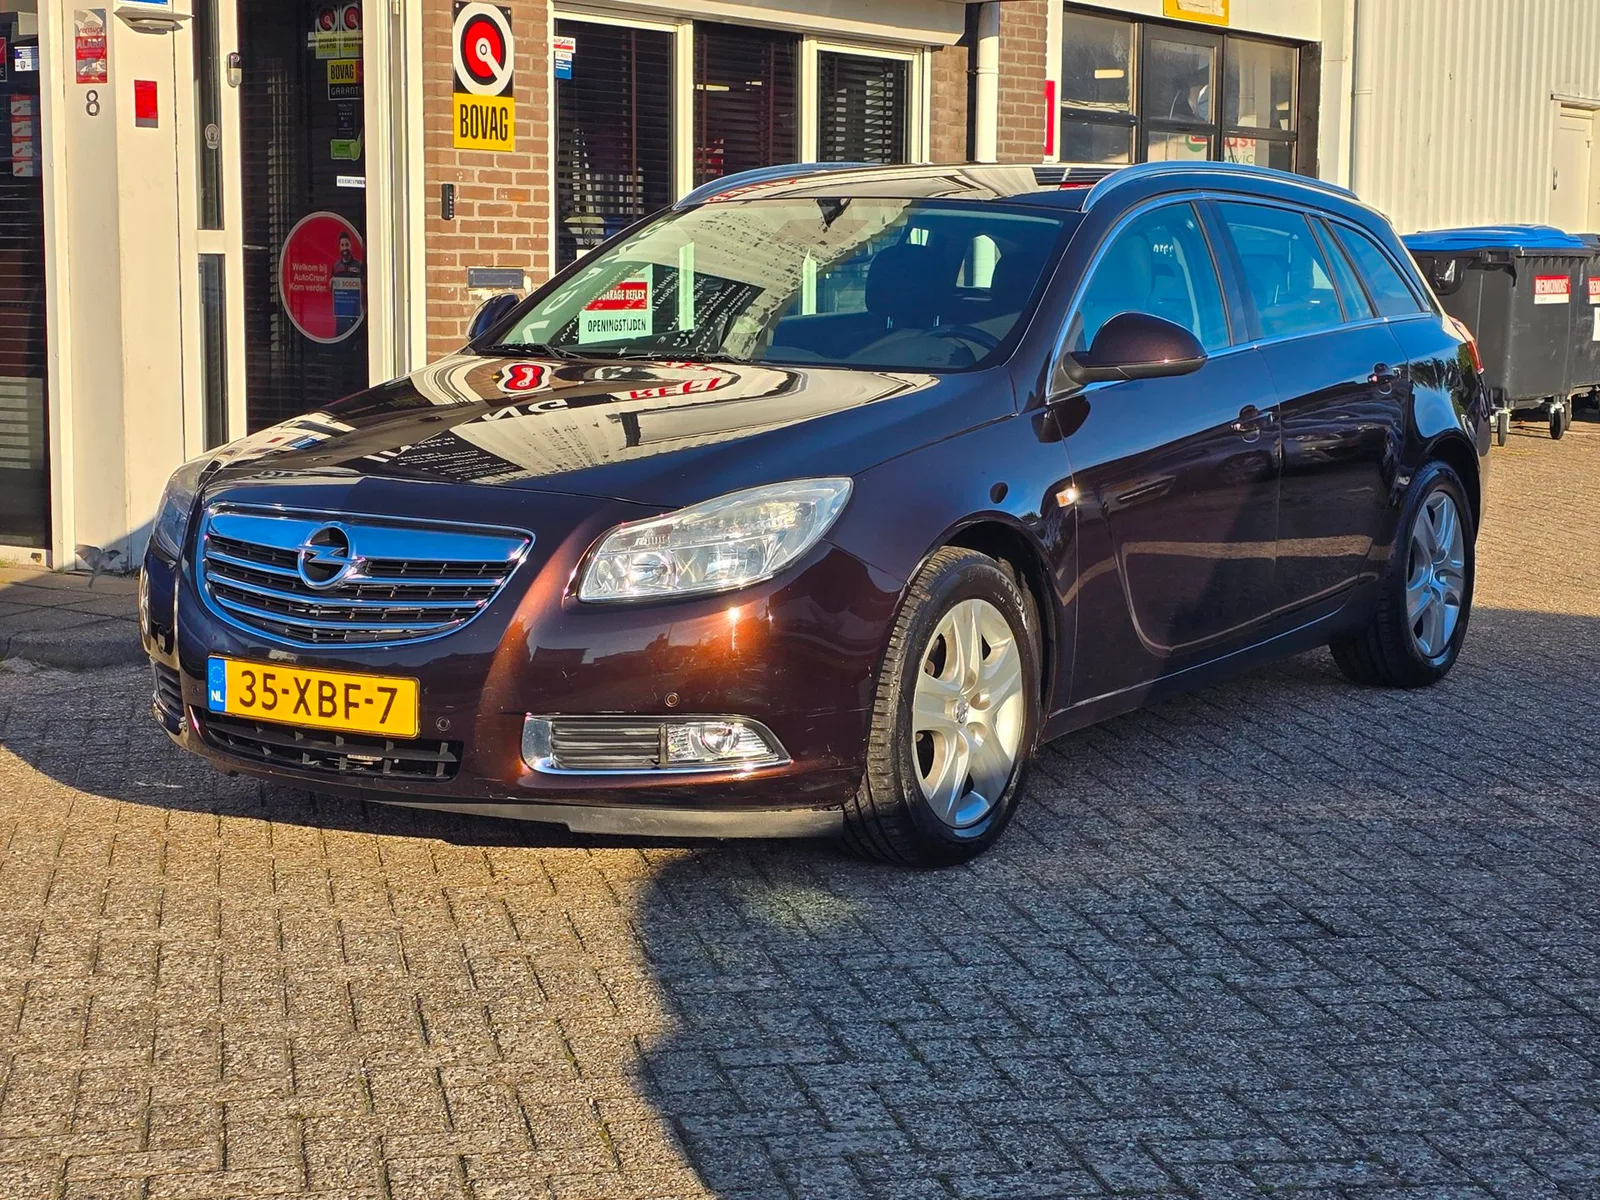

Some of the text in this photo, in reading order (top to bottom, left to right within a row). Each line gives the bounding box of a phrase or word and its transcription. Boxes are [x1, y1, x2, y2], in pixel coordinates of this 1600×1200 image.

[330, 64, 354, 80] BOVAG
[86, 90, 100, 116] 8
[459, 103, 509, 141] BOVAG
[292, 263, 328, 273] Welkom bij
[289, 283, 328, 292] Kom verder.
[1535, 279, 1568, 294] REMONDIS
[626, 289, 647, 300] REFLEX
[587, 319, 647, 332] OPENINGSTIJDEN
[211, 690, 224, 702] NL
[239, 669, 398, 724] 35-XBF-7
